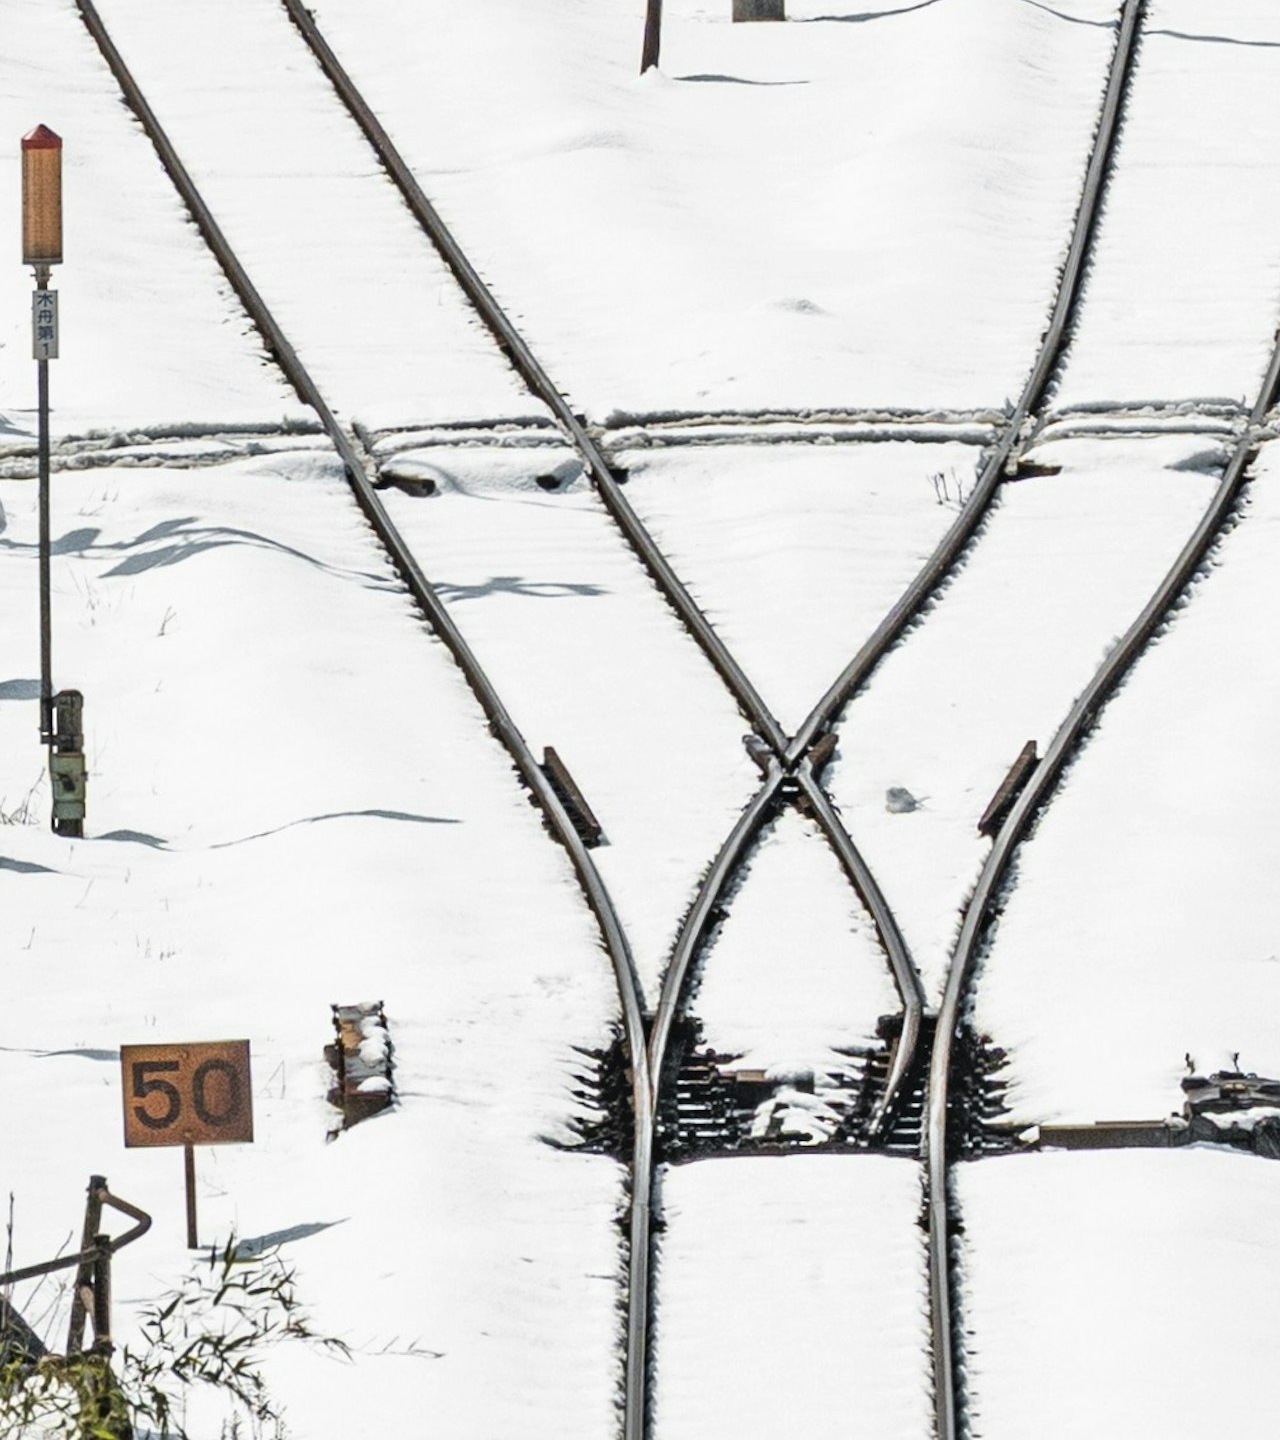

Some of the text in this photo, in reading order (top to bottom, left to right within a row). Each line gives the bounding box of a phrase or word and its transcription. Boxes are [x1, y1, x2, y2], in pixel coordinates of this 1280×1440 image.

[37, 292, 53, 355] 木舟第1
[133, 1060, 238, 1129] 50
